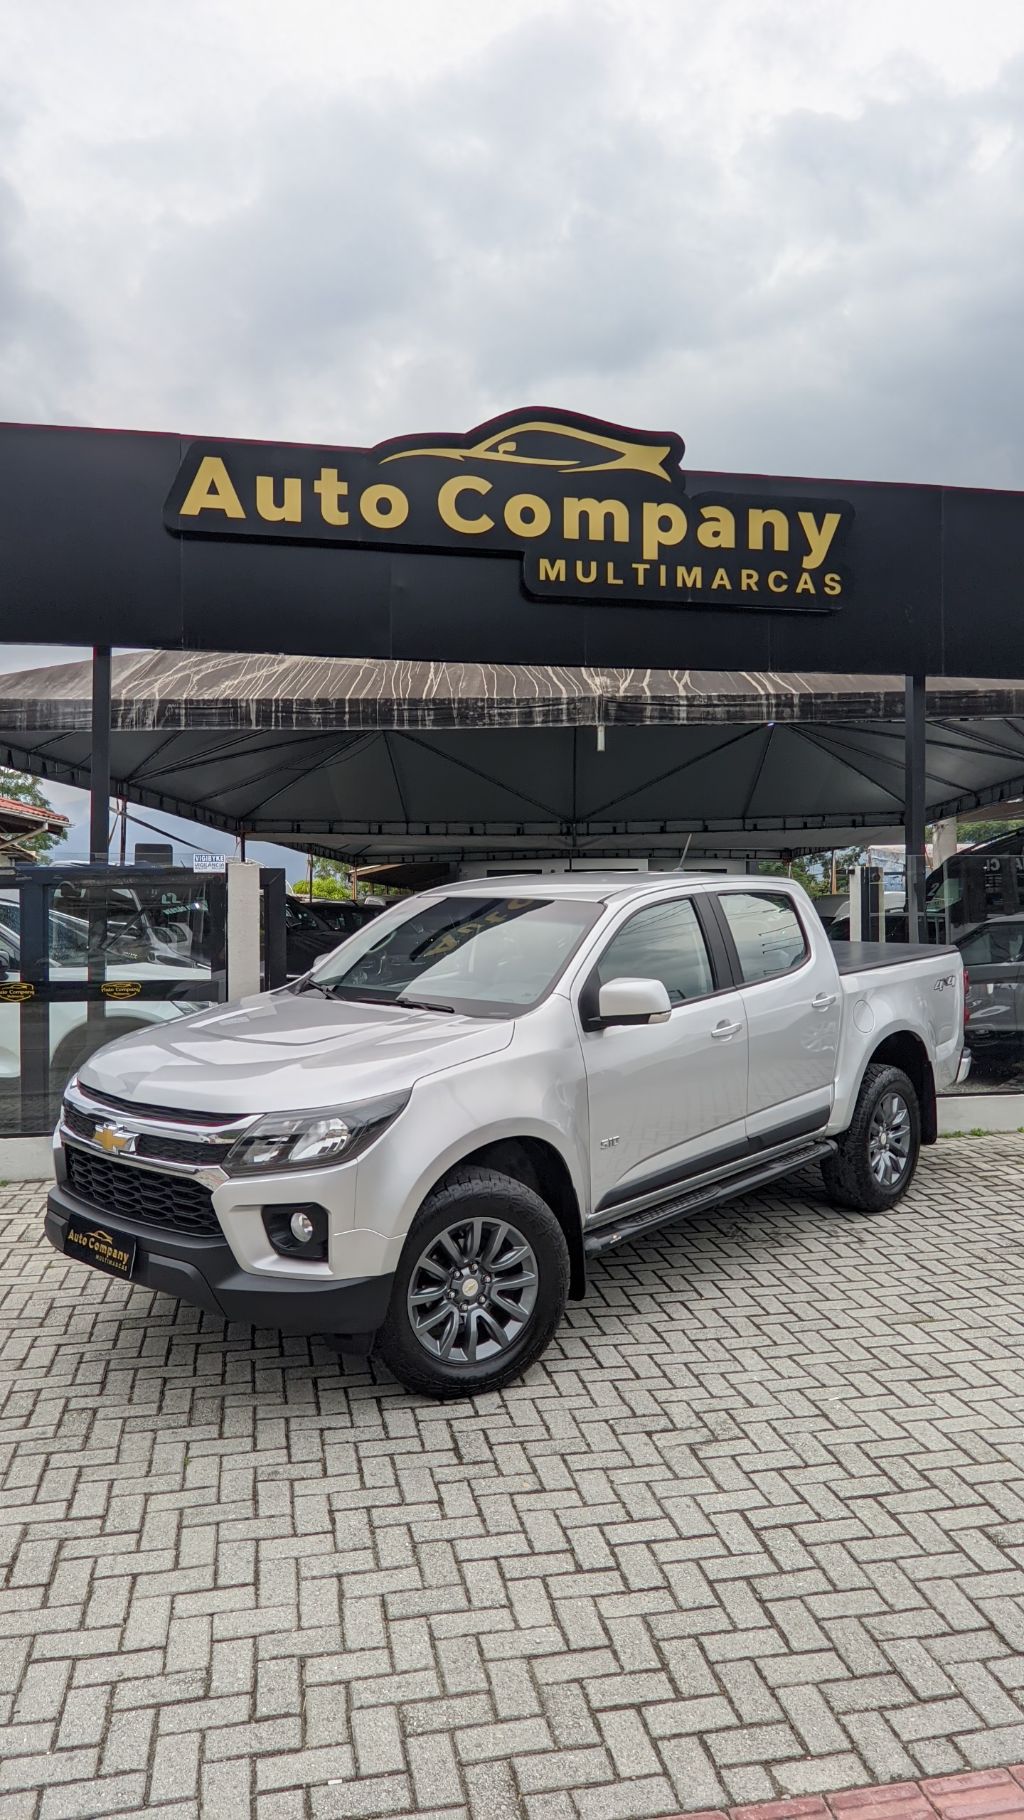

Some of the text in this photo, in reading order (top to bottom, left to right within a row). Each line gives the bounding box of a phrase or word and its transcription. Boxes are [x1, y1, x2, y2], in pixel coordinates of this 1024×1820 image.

[179, 456, 842, 570] Auto Company
[539, 558, 843, 596] MULTIMARCAS
[68, 1229, 129, 1264] Auto Company
